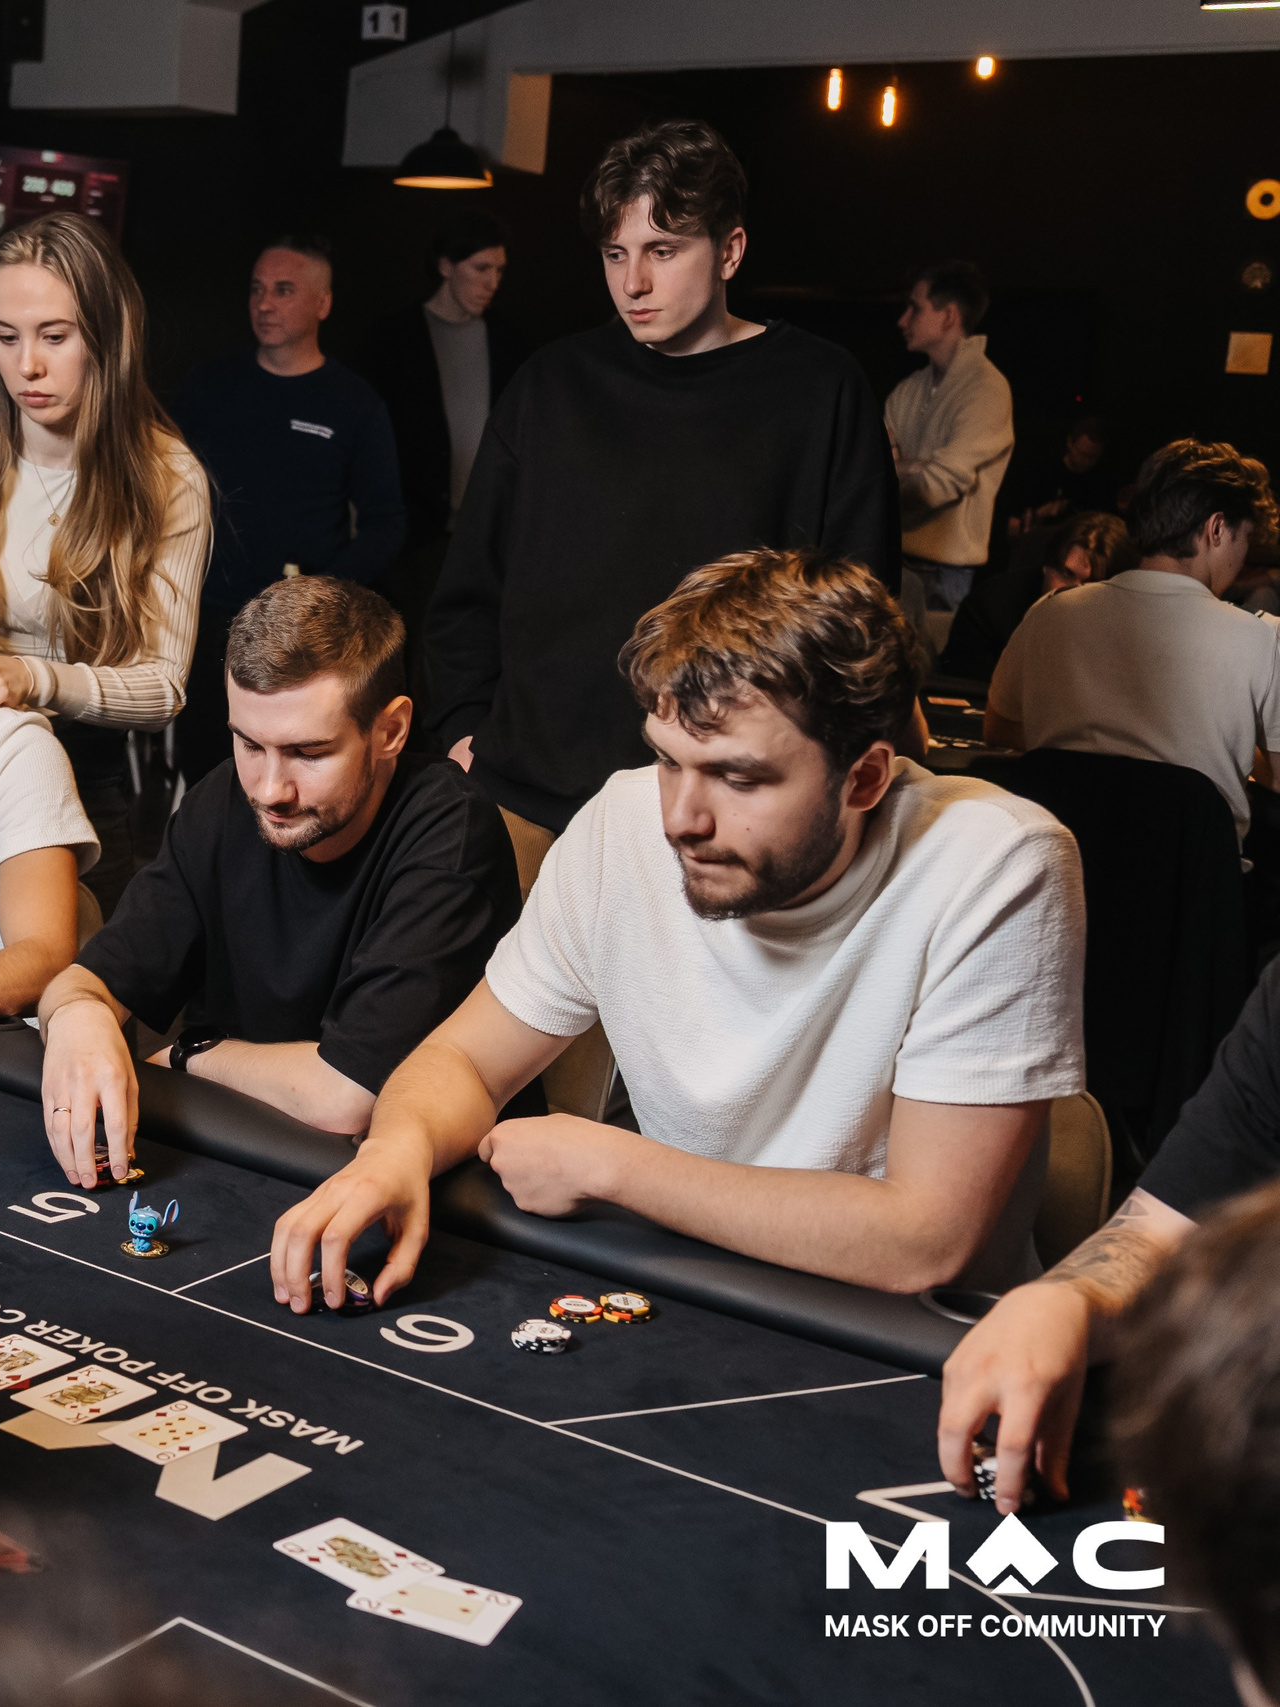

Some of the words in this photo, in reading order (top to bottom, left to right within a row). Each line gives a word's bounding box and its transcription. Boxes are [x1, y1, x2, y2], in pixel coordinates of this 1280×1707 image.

[7, 1191, 100, 1223] 5
[24, 1319, 156, 1374] POKER
[147, 1372, 232, 1403] OFF
[228, 1398, 364, 1455] MASK
